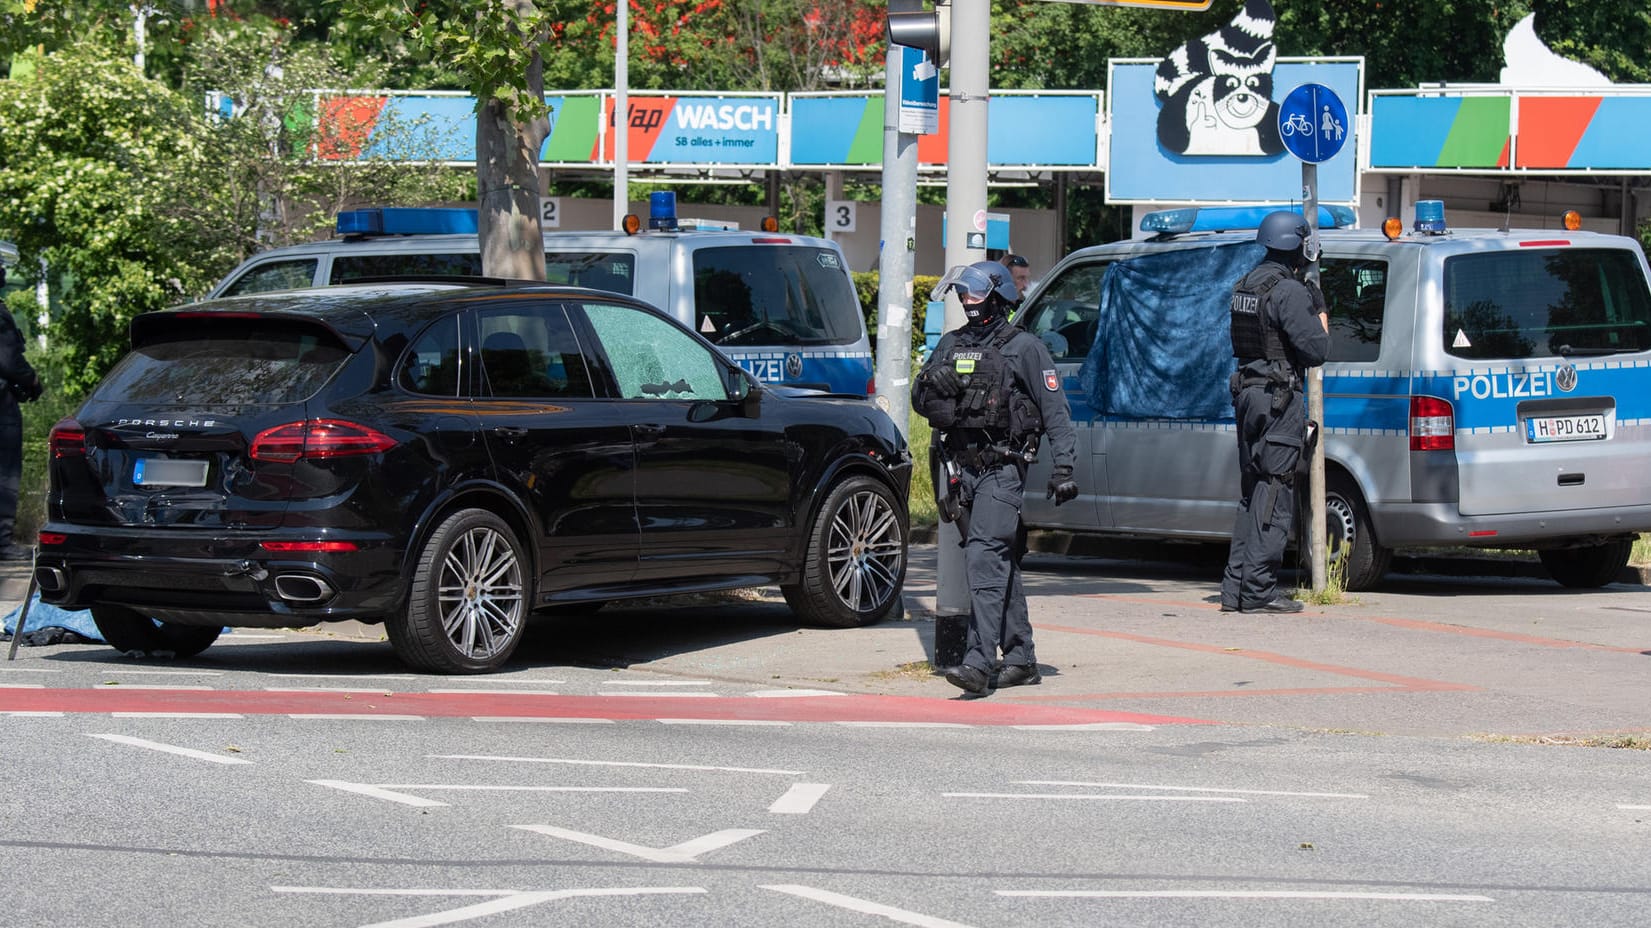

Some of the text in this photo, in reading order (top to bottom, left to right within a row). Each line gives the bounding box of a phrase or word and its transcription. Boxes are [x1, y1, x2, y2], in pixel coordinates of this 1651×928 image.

[675, 104, 772, 130] WASCH
[675, 136, 688, 146] SB
[543, 201, 556, 221] 2
[836, 205, 851, 227] 3
[952, 352, 982, 361] POLIZEI
[737, 360, 785, 382] IZEI
[1453, 372, 1553, 401] POLIZEI
[118, 419, 216, 427] PORSCHE
[1539, 420, 1549, 436] H
[1556, 419, 1573, 435] PD
[1576, 418, 1600, 434] 612
